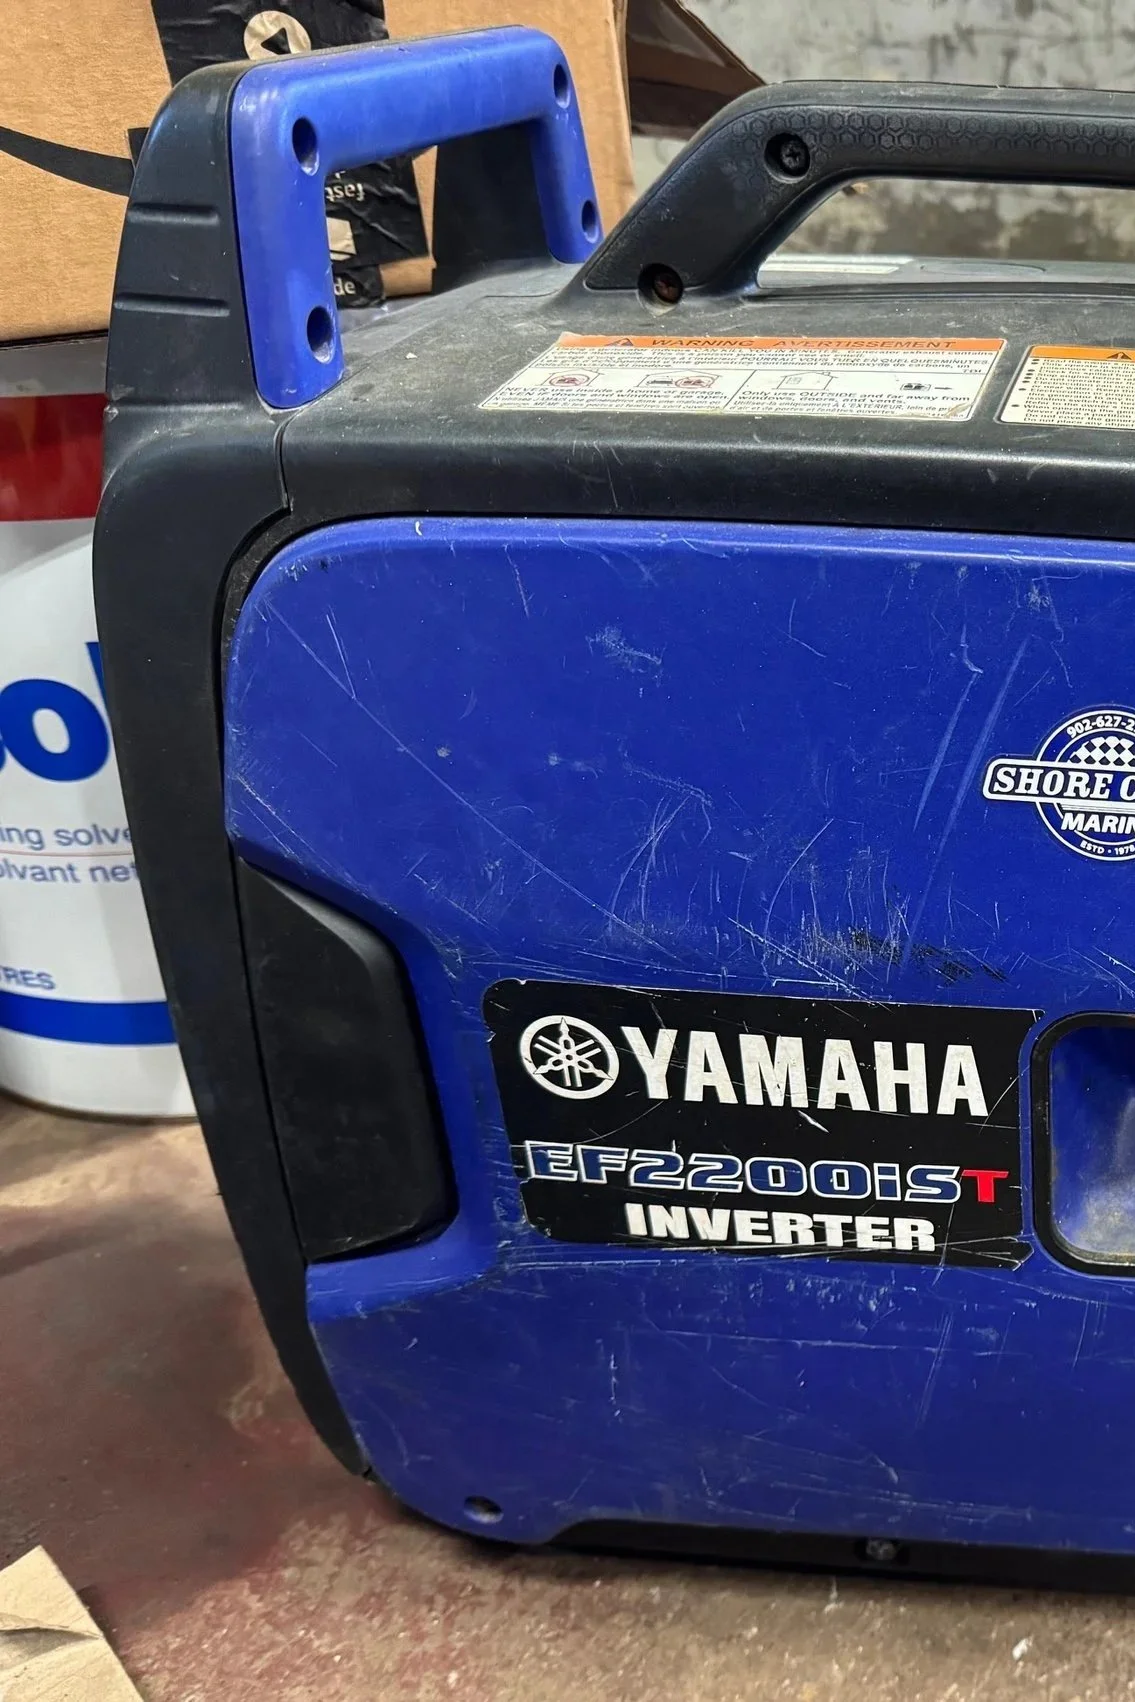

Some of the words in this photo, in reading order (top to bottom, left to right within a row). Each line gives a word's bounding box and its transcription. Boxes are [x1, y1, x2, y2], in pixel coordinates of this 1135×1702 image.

[651, 339, 754, 348] WARNING
[773, 340, 957, 349] AVERTISSEMENT
[993, 767, 1113, 799] SHORE
[1080, 840, 1105, 854] ESTD
[621, 1025, 990, 1117] YAMAHA
[524, 1140, 1009, 1204] EF2200iST
[625, 1203, 936, 1252] INVERTER
